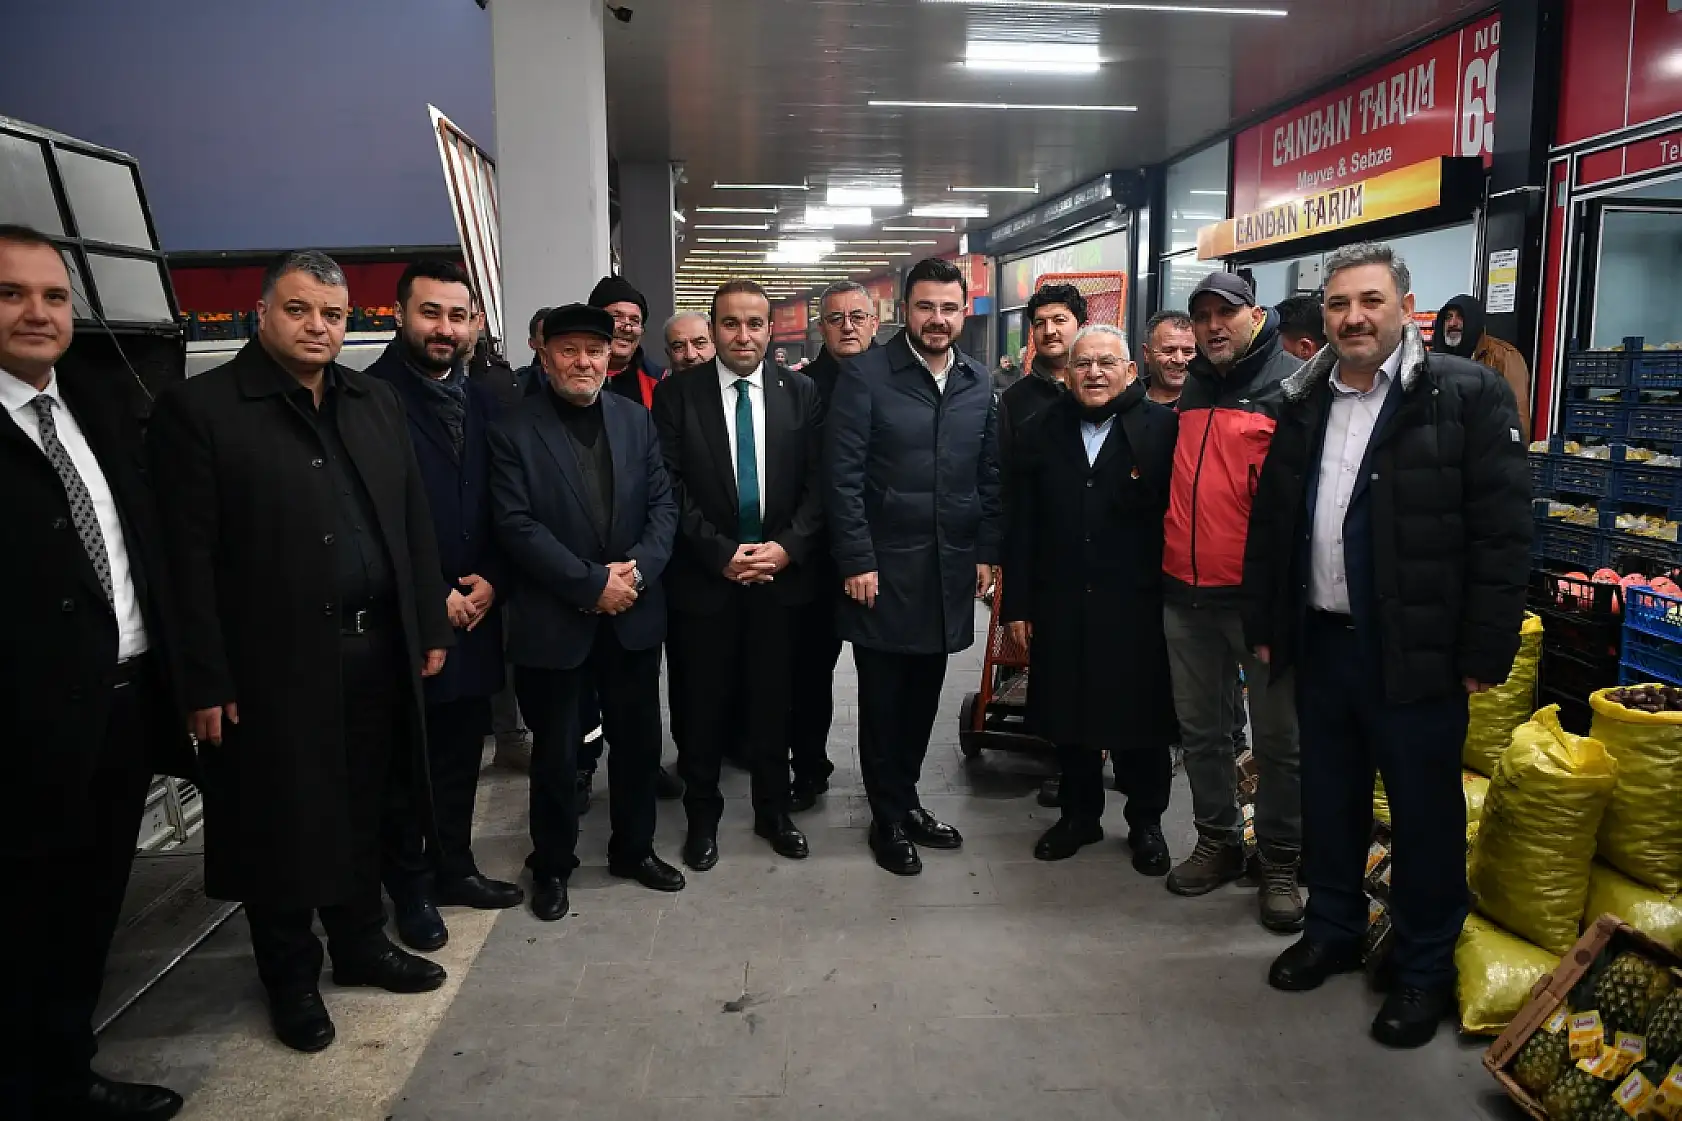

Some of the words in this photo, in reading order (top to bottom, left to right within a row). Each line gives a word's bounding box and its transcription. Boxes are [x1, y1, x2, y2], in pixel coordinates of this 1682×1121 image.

[1272, 95, 1353, 168] CANDAN
[1359, 58, 1436, 135] TARIM
[1296, 165, 1334, 191] Meyve
[1337, 156, 1348, 178] &
[1351, 145, 1392, 173] Sebze
[1235, 203, 1299, 246] CANDAN
[1304, 183, 1364, 230] TARIM
